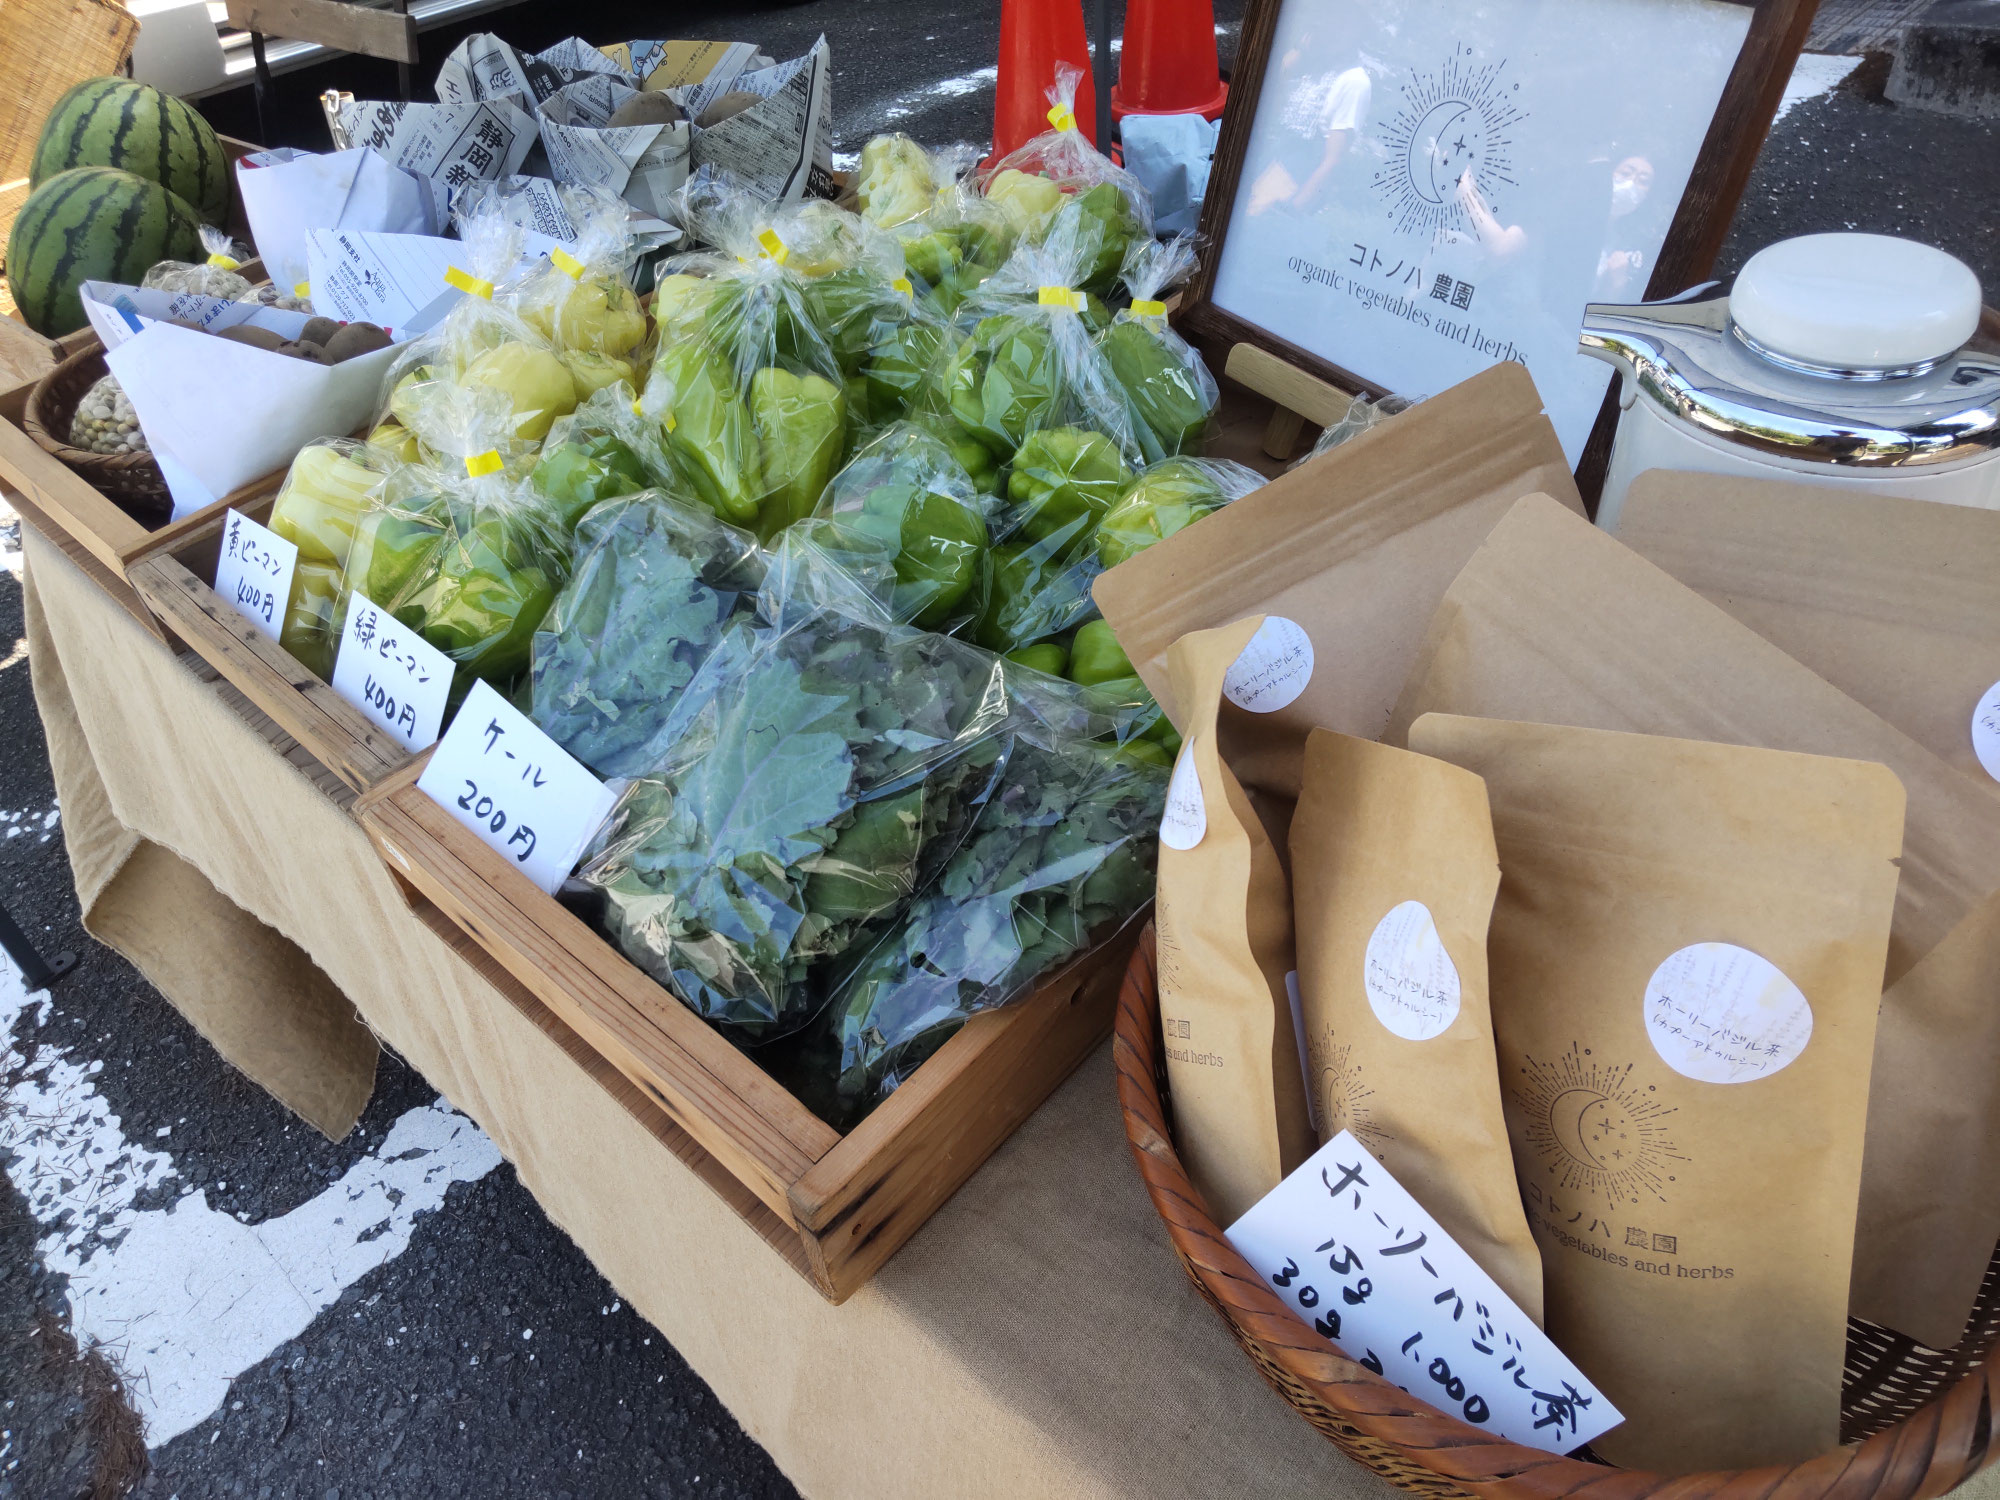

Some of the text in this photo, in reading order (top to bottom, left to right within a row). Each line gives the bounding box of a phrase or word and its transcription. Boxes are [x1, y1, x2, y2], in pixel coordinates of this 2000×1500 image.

[371, 272, 386, 292] Aqua
[371, 282, 388, 303] Clara
[1349, 243, 1476, 311] コトノハ 農園
[1287, 255, 1528, 367] organic vegetables and herbs
[238, 576, 274, 623] 400円
[354, 608, 430, 683] 緑ピーマン
[1234, 646, 1304, 695] ホーリーバジル茶
[365, 674, 416, 739] 400円
[484, 717, 548, 788] ケール
[458, 779, 537, 862] 200円
[1371, 959, 1447, 1007] ホーリーバジル茶
[1174, 1049, 1188, 1062] and
[1191, 1050, 1223, 1067] herbs
[1658, 995, 1782, 1057] ホーリーバジル茶
[1530, 1182, 1611, 1238] コトノハ
[1625, 1226, 1677, 1254] 農園
[1544, 1218, 1735, 1279] vegetables and herbs
[1272, 1257, 1342, 1340] 30g
[1315, 1237, 1373, 1306] 15g
[1321, 1160, 1593, 1443] ホーリーバジル茶
